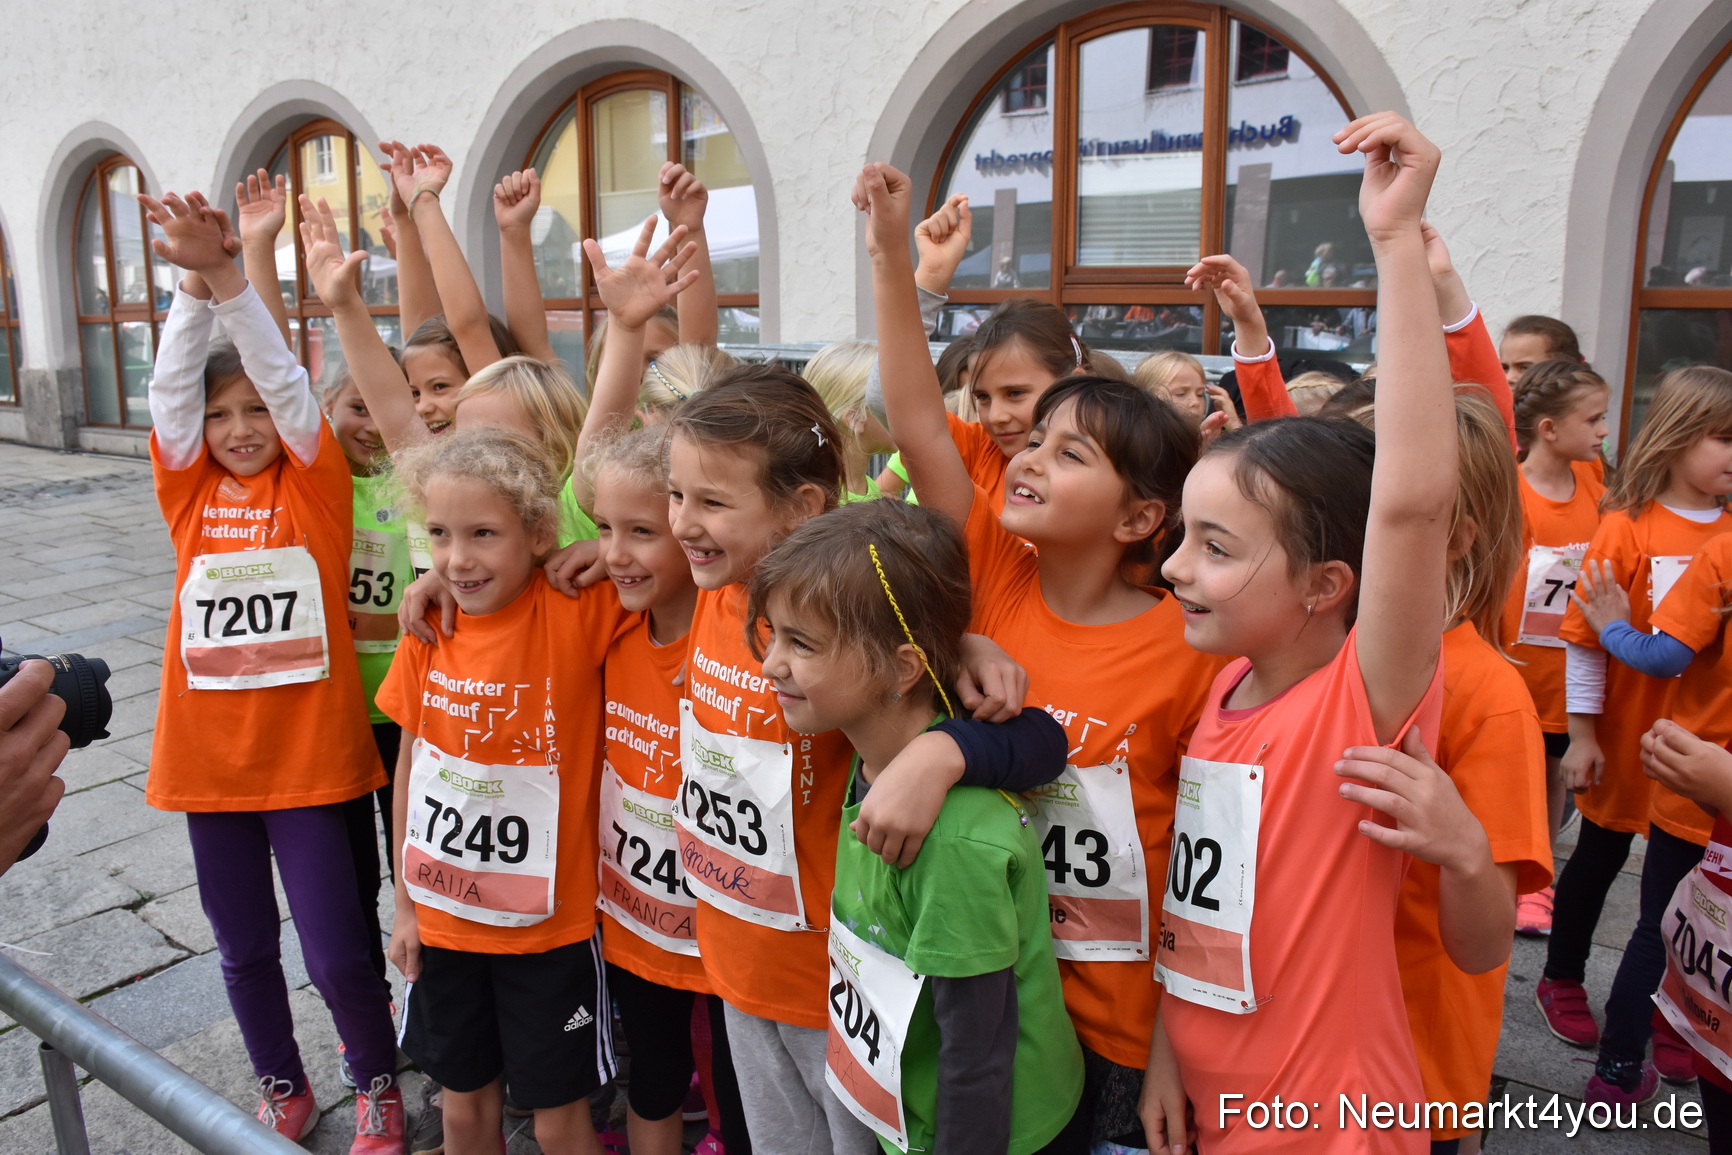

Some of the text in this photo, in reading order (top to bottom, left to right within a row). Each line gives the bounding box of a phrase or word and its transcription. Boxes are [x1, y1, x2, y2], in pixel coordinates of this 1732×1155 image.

[353, 539, 386, 555] OCK
[221, 563, 274, 579] BOCK
[348, 567, 395, 607] 53
[1544, 578, 1577, 607] 71
[196, 591, 298, 638] 7207
[605, 696, 679, 740] eumarkter
[691, 672, 742, 722] tadtlauf
[695, 739, 735, 773] BOCK
[451, 771, 505, 794] BOCK
[424, 795, 530, 864] 7249
[1041, 824, 1111, 888] 43
[1164, 831, 1222, 912] 02
[418, 862, 481, 903] RAIJA
[613, 880, 692, 937] FRANCA
[1672, 907, 1732, 1006] 7047
[564, 1015, 593, 1032] adidas
[830, 955, 881, 1067] 204
